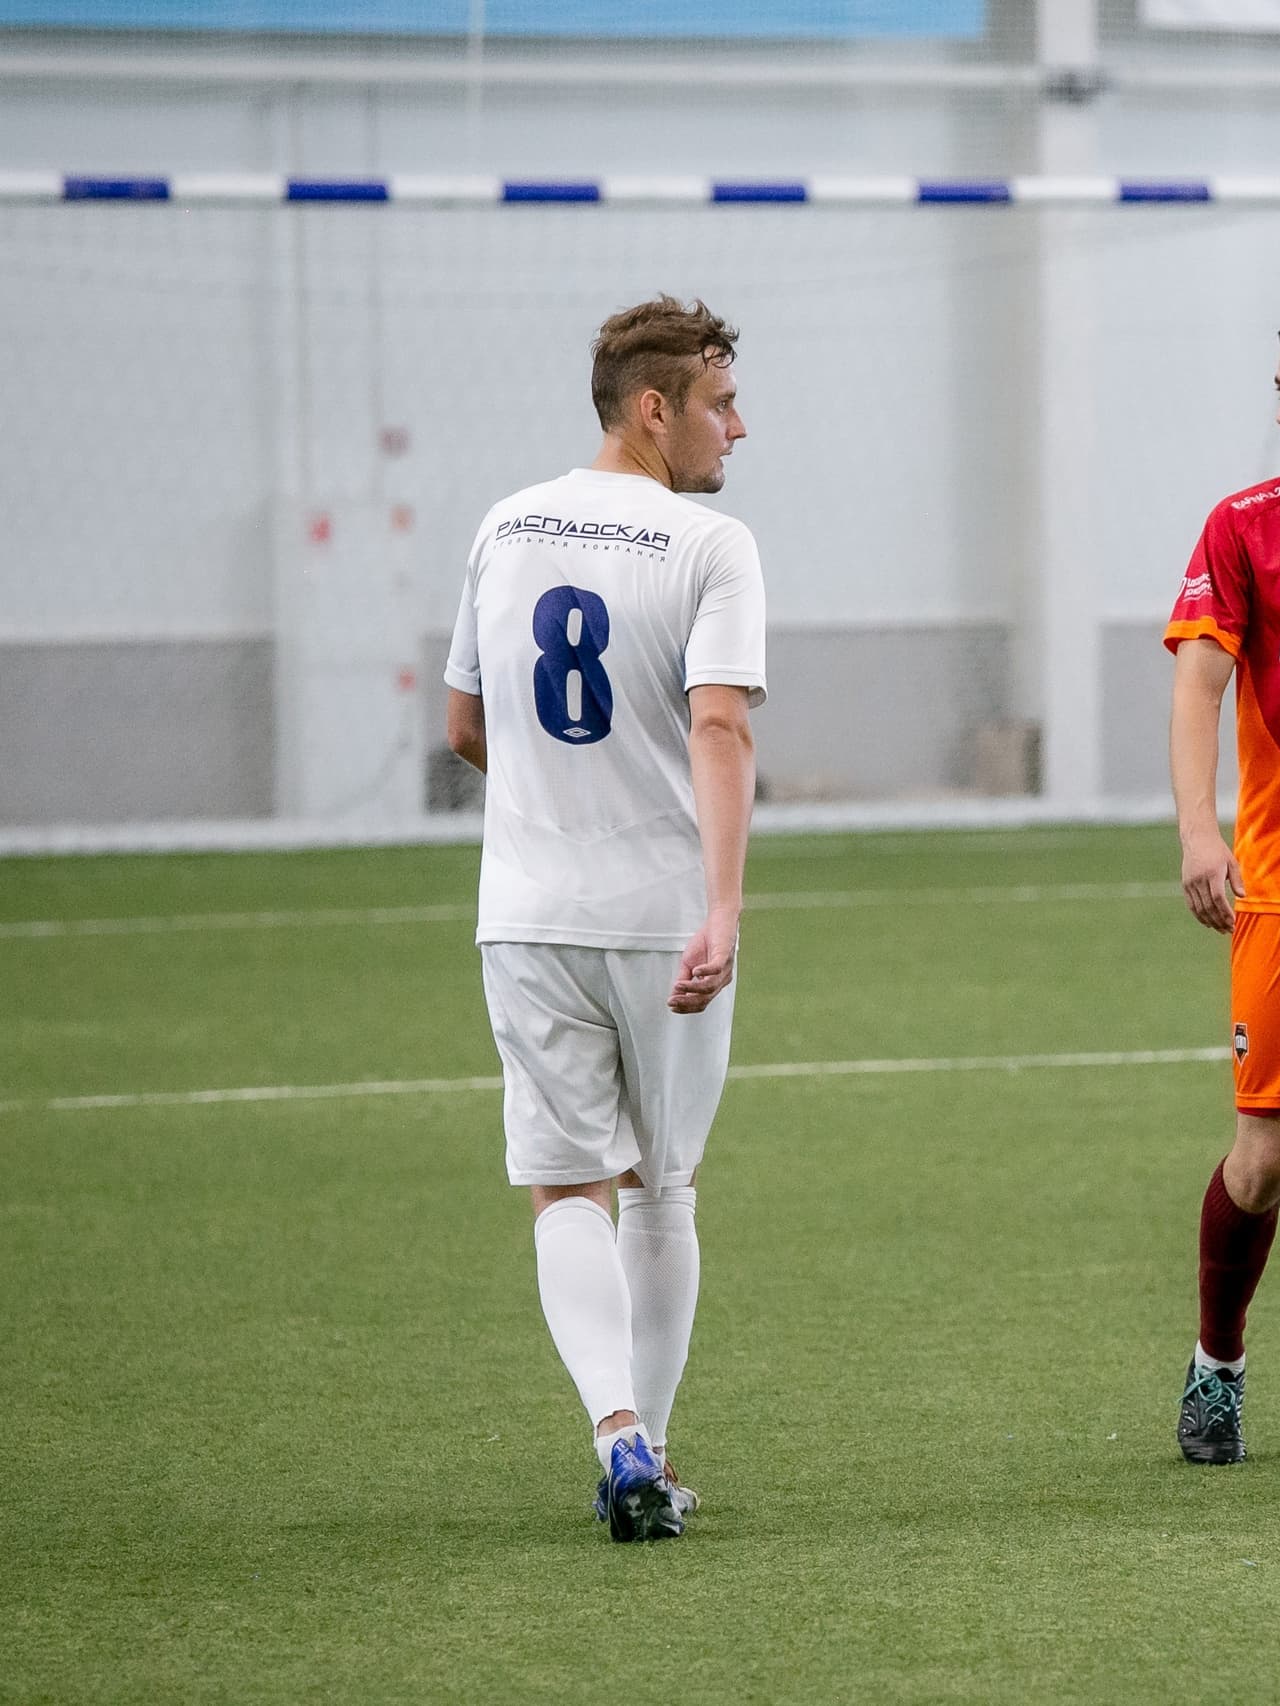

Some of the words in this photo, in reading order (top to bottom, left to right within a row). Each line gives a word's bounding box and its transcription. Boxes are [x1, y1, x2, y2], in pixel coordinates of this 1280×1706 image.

[496, 515, 671, 549] РАСПАДСКАЯ
[582, 543, 666, 562] КОМПАНИЯ
[532, 585, 614, 746] 8
